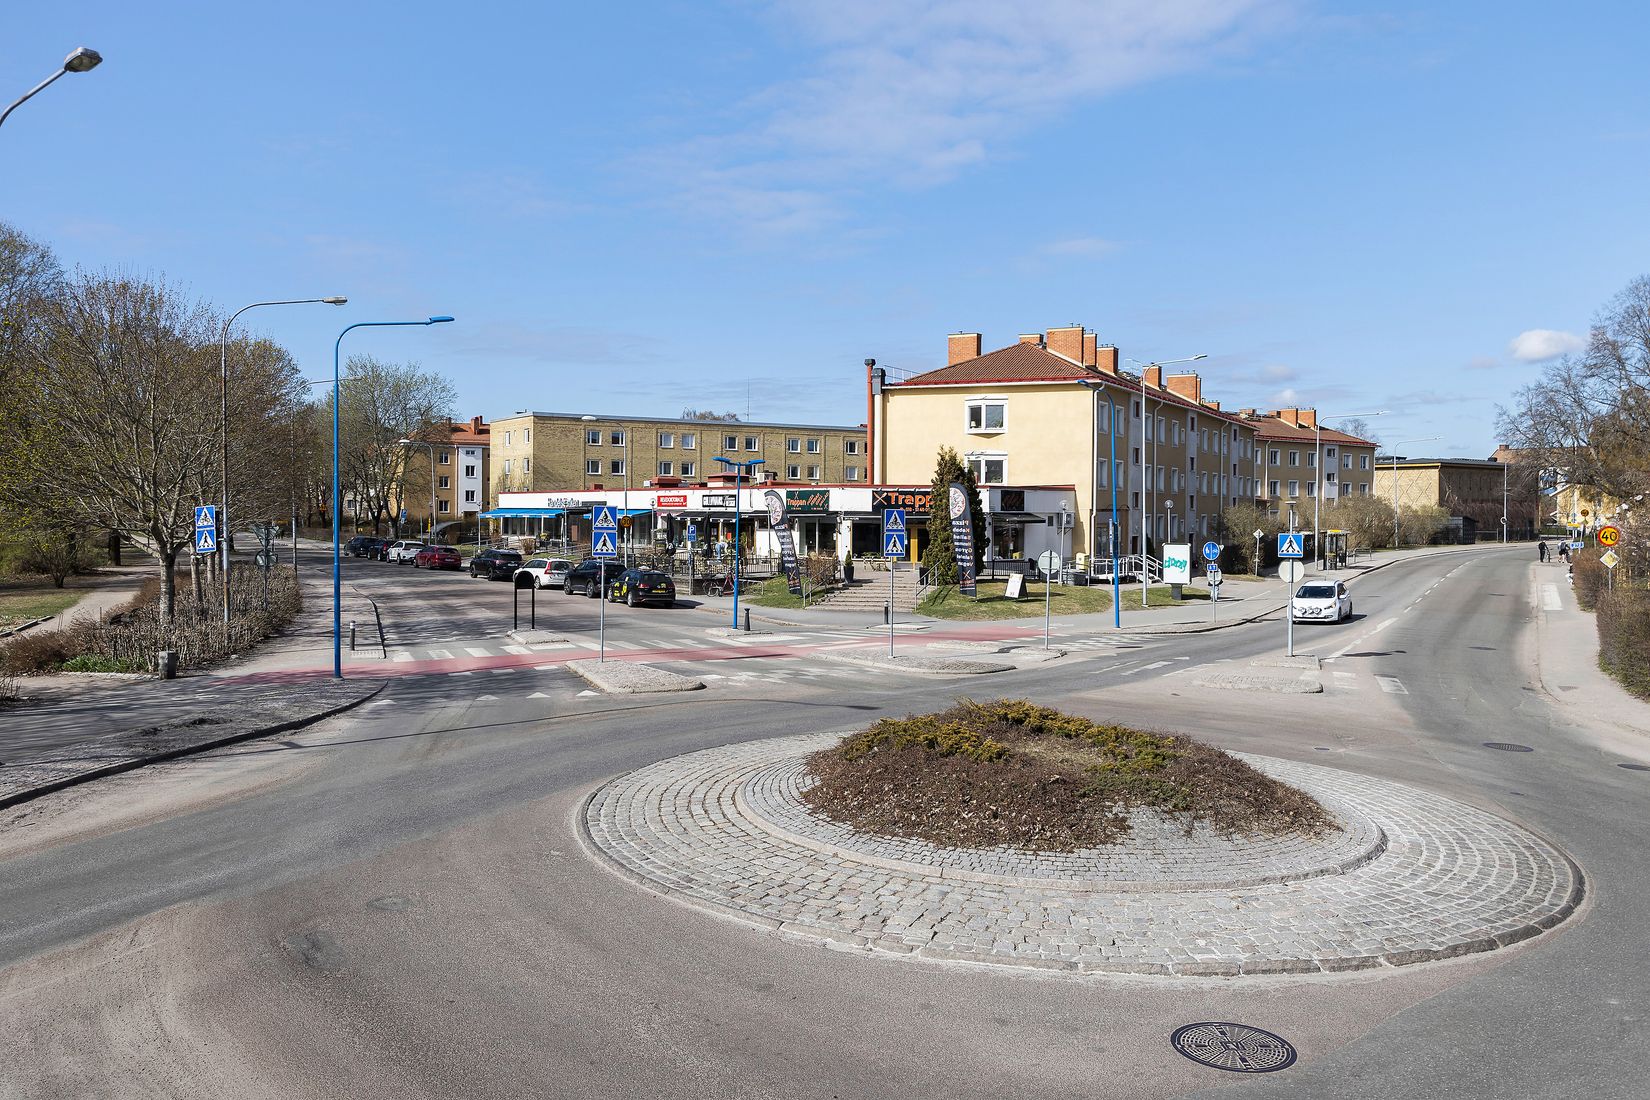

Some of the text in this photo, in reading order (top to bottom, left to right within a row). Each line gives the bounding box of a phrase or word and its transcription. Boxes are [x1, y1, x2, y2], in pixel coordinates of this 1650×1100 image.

[786, 498, 806, 507] Trappan
[888, 492, 934, 507] Trapp
[1601, 532, 1617, 541] 40
